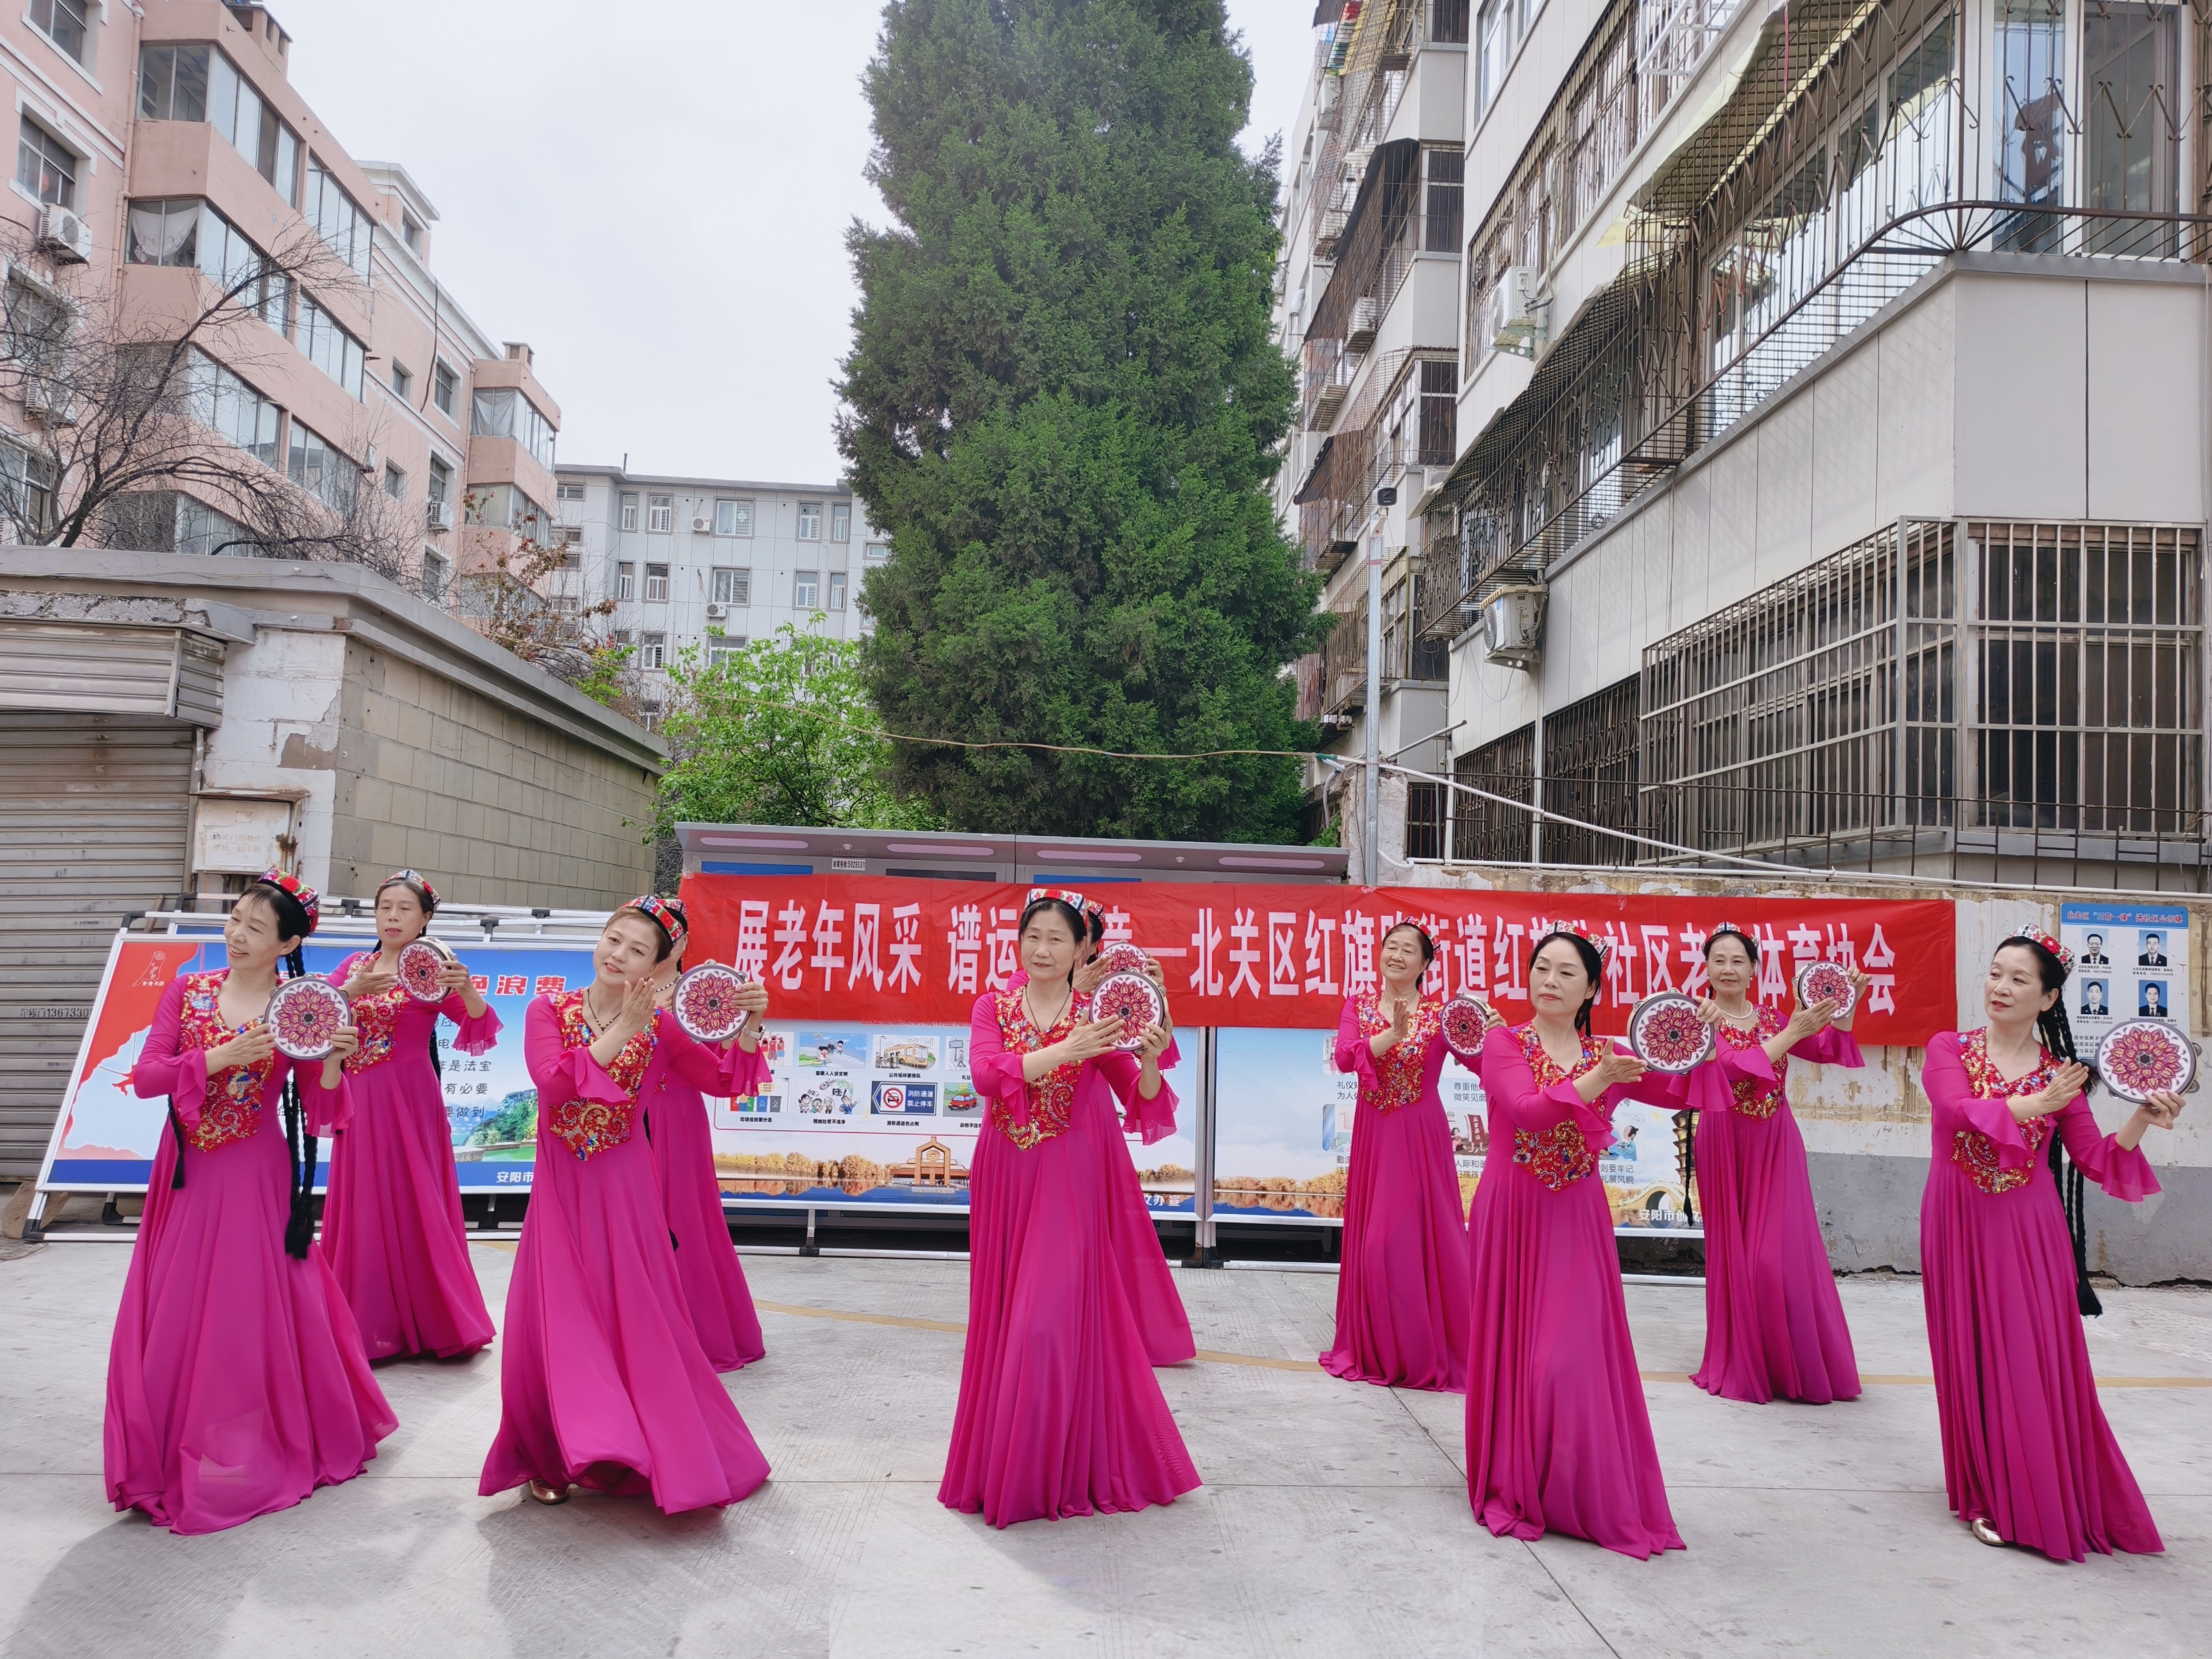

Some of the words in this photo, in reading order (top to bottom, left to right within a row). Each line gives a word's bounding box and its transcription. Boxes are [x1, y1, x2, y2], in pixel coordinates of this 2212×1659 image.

[213, 845, 261, 853] 停放一切车辆
[2067, 911, 2090, 920] 北关区
[2135, 914, 2183, 924] 进社区公示牌
[734, 899, 922, 994] 展老年风采
[444, 1083, 488, 1095] 有必要
[1454, 1082, 1485, 1092] 尊重他
[1454, 1093, 1486, 1102] 微笑见面
[1598, 1164, 1634, 1173] 则要牢记
[1639, 1209, 1703, 1222] 安阳市创文
